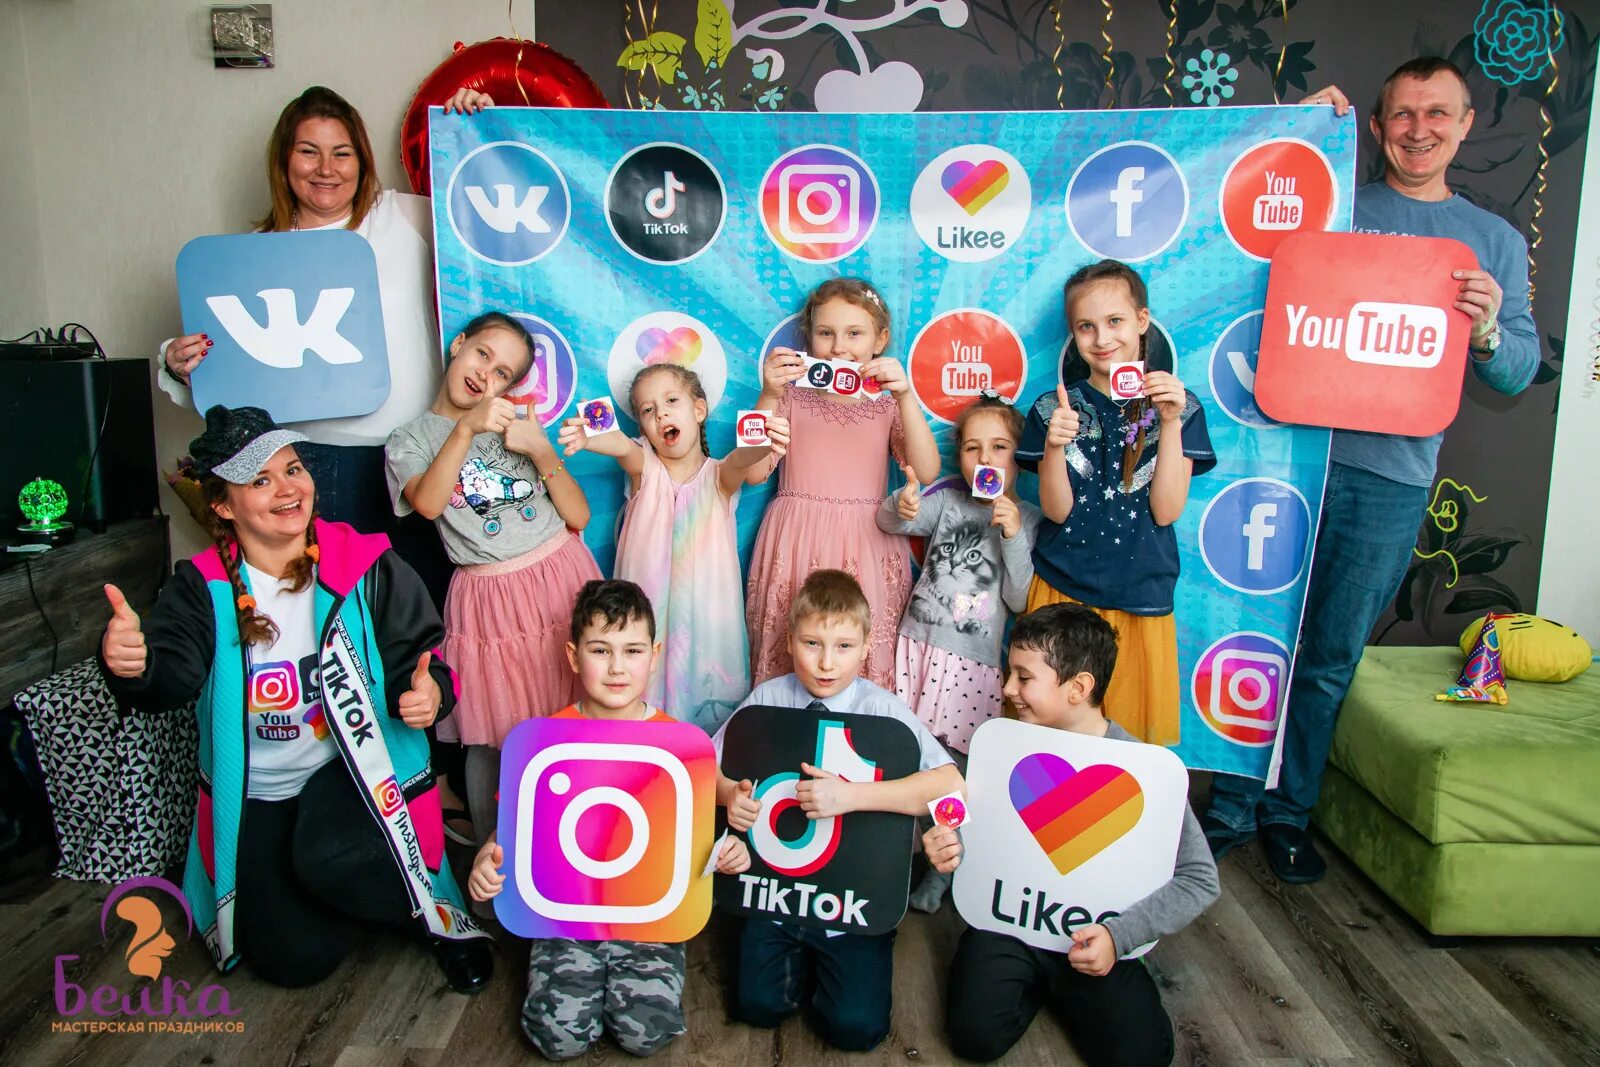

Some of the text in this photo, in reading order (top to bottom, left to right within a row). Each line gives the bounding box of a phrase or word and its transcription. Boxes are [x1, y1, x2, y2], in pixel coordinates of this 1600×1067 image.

[1265, 171, 1295, 195] You
[1259, 200, 1299, 224] Tube
[643, 223, 688, 235] TikTok
[937, 226, 1006, 249] Likee
[951, 340, 982, 363] You
[946, 367, 990, 391] Tube
[321, 651, 374, 748] TikTok
[259, 712, 291, 725] You
[258, 726, 297, 739] Tube
[394, 811, 433, 897] Instagram
[739, 874, 869, 927] TikTok
